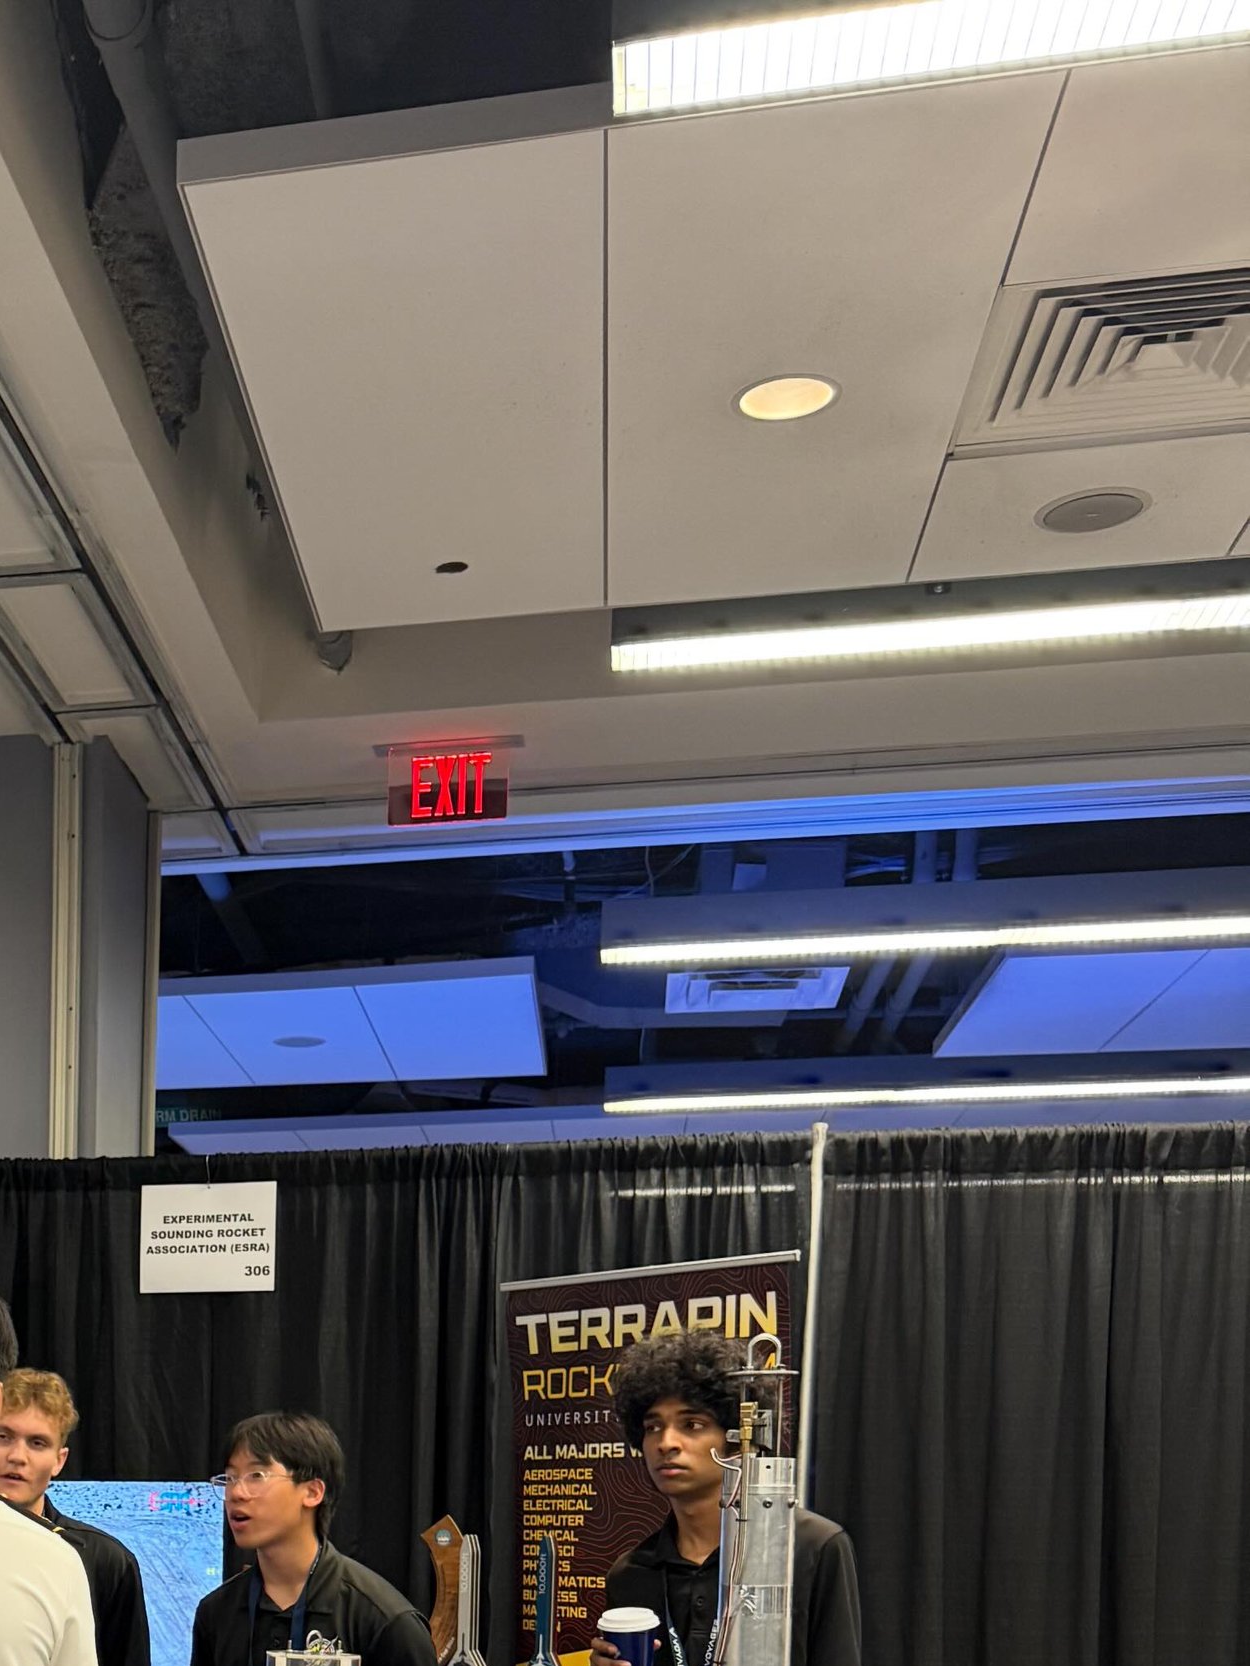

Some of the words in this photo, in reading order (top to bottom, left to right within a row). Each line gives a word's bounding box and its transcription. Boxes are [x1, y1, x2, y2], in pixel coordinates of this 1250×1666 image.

[411, 752, 492, 818] EXIT
[163, 1213, 255, 1224] EXPERIMENTAL
[151, 1229, 213, 1240] SOUNDING
[217, 1227, 267, 1238] ROCKET
[146, 1244, 227, 1255] ASSOCIATION
[230, 1242, 270, 1254] (ESRA)
[244, 1265, 271, 1277] 306
[515, 1290, 778, 1355] TERRAPIN
[522, 1365, 617, 1401] ROCK
[525, 1409, 619, 1427] UNIVERSIT
[524, 1445, 553, 1460] ALL
[555, 1442, 625, 1459] MAJORS
[523, 1468, 594, 1481] AEROSPACE
[523, 1484, 597, 1497] MECHANICAL
[523, 1499, 593, 1511] ELECTRICAL
[523, 1514, 585, 1526] COMPUTER
[523, 1574, 606, 1589] MAMATICS
